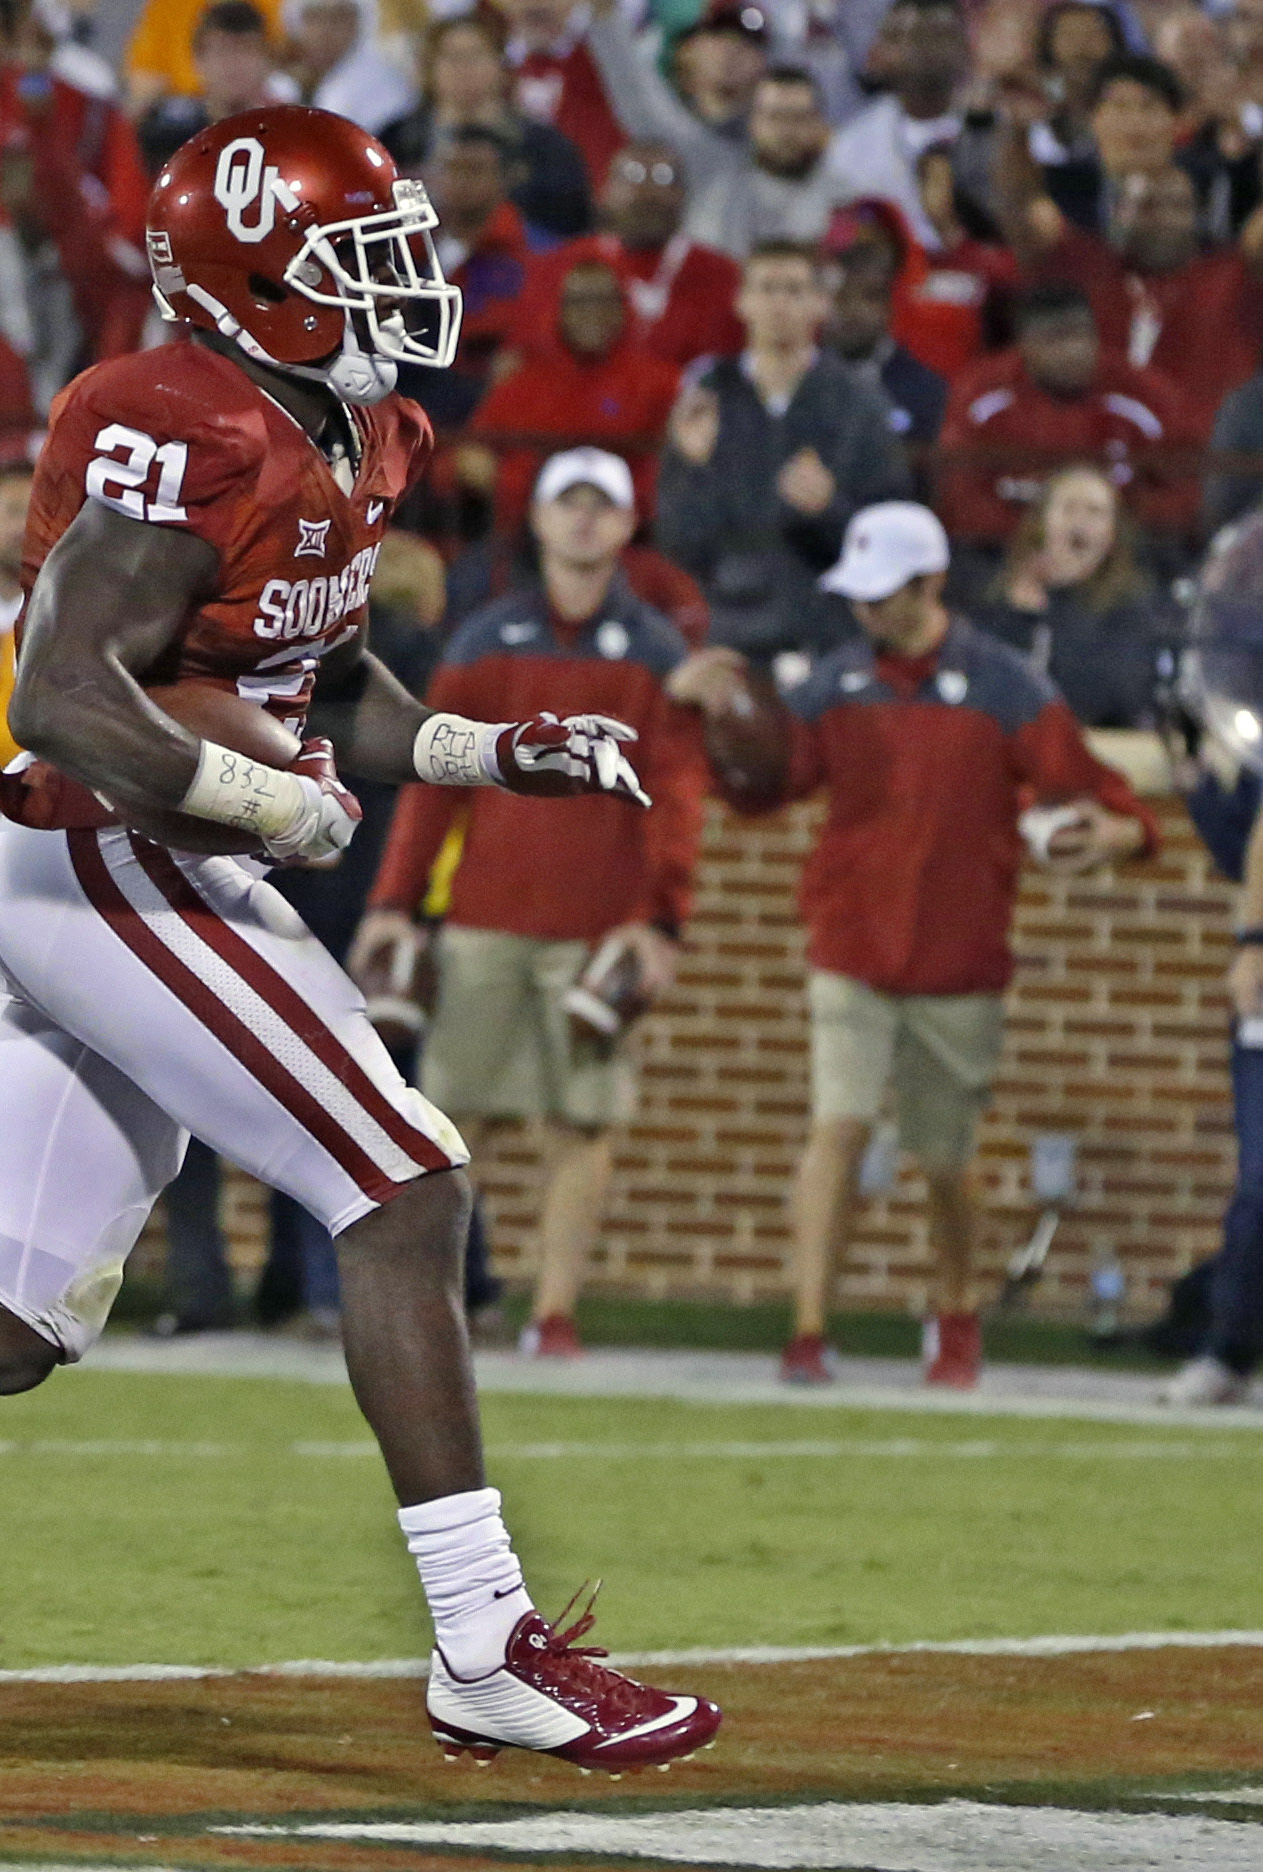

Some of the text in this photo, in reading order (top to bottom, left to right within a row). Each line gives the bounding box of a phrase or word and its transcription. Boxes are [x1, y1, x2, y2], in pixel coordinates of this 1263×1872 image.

[214, 137, 280, 243] OU
[87, 423, 188, 521] 21
[220, 754, 275, 798] 832
[431, 723, 475, 758] RIP
